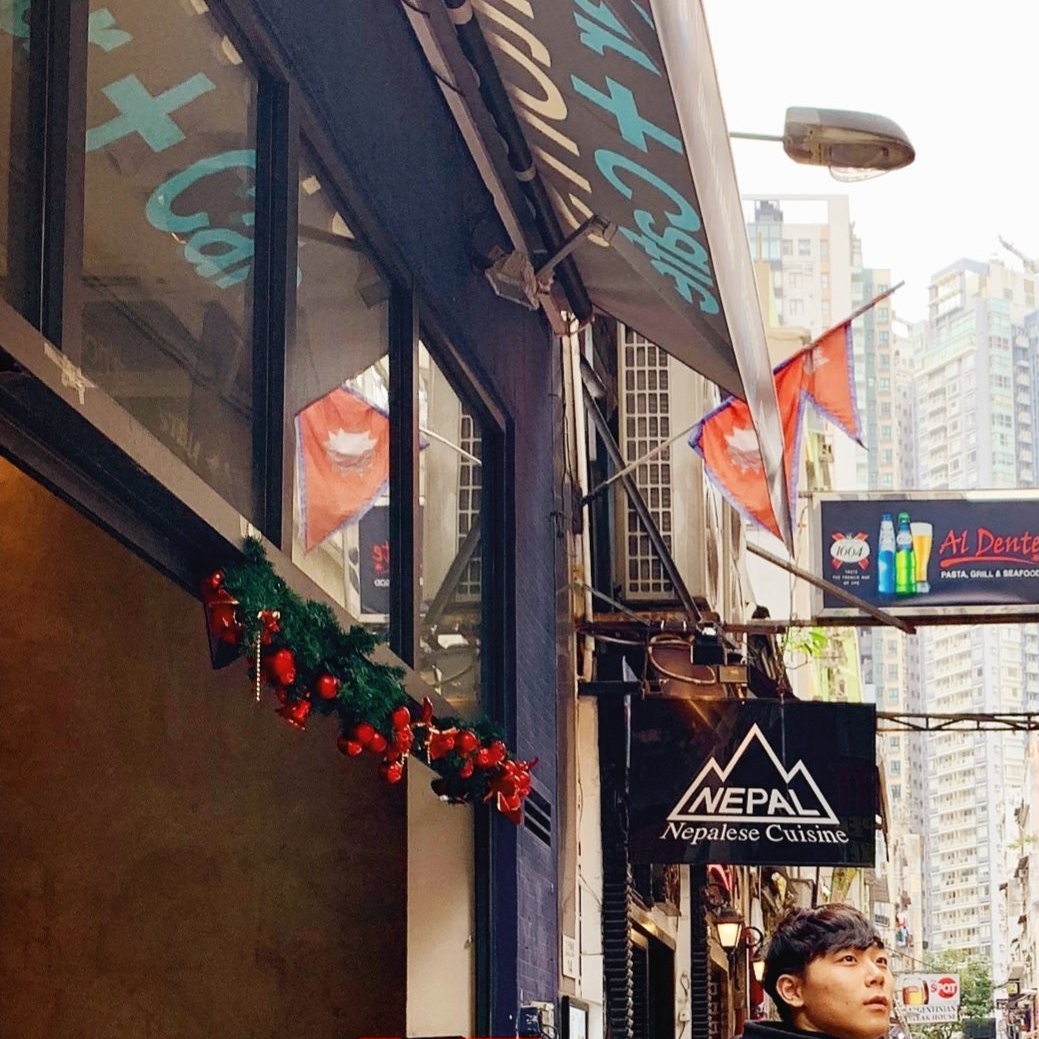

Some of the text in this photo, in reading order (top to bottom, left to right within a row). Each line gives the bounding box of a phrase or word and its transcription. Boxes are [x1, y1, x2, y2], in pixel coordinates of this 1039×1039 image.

[939, 530, 969, 555] Al
[941, 570, 969, 579] PASTA,
[970, 569, 994, 578] GRILL
[995, 569, 1001, 578] &
[688, 786, 821, 817] NEPAL
[660, 821, 849, 845] Nepalese Cuisine
[931, 983, 958, 994] SPOT
